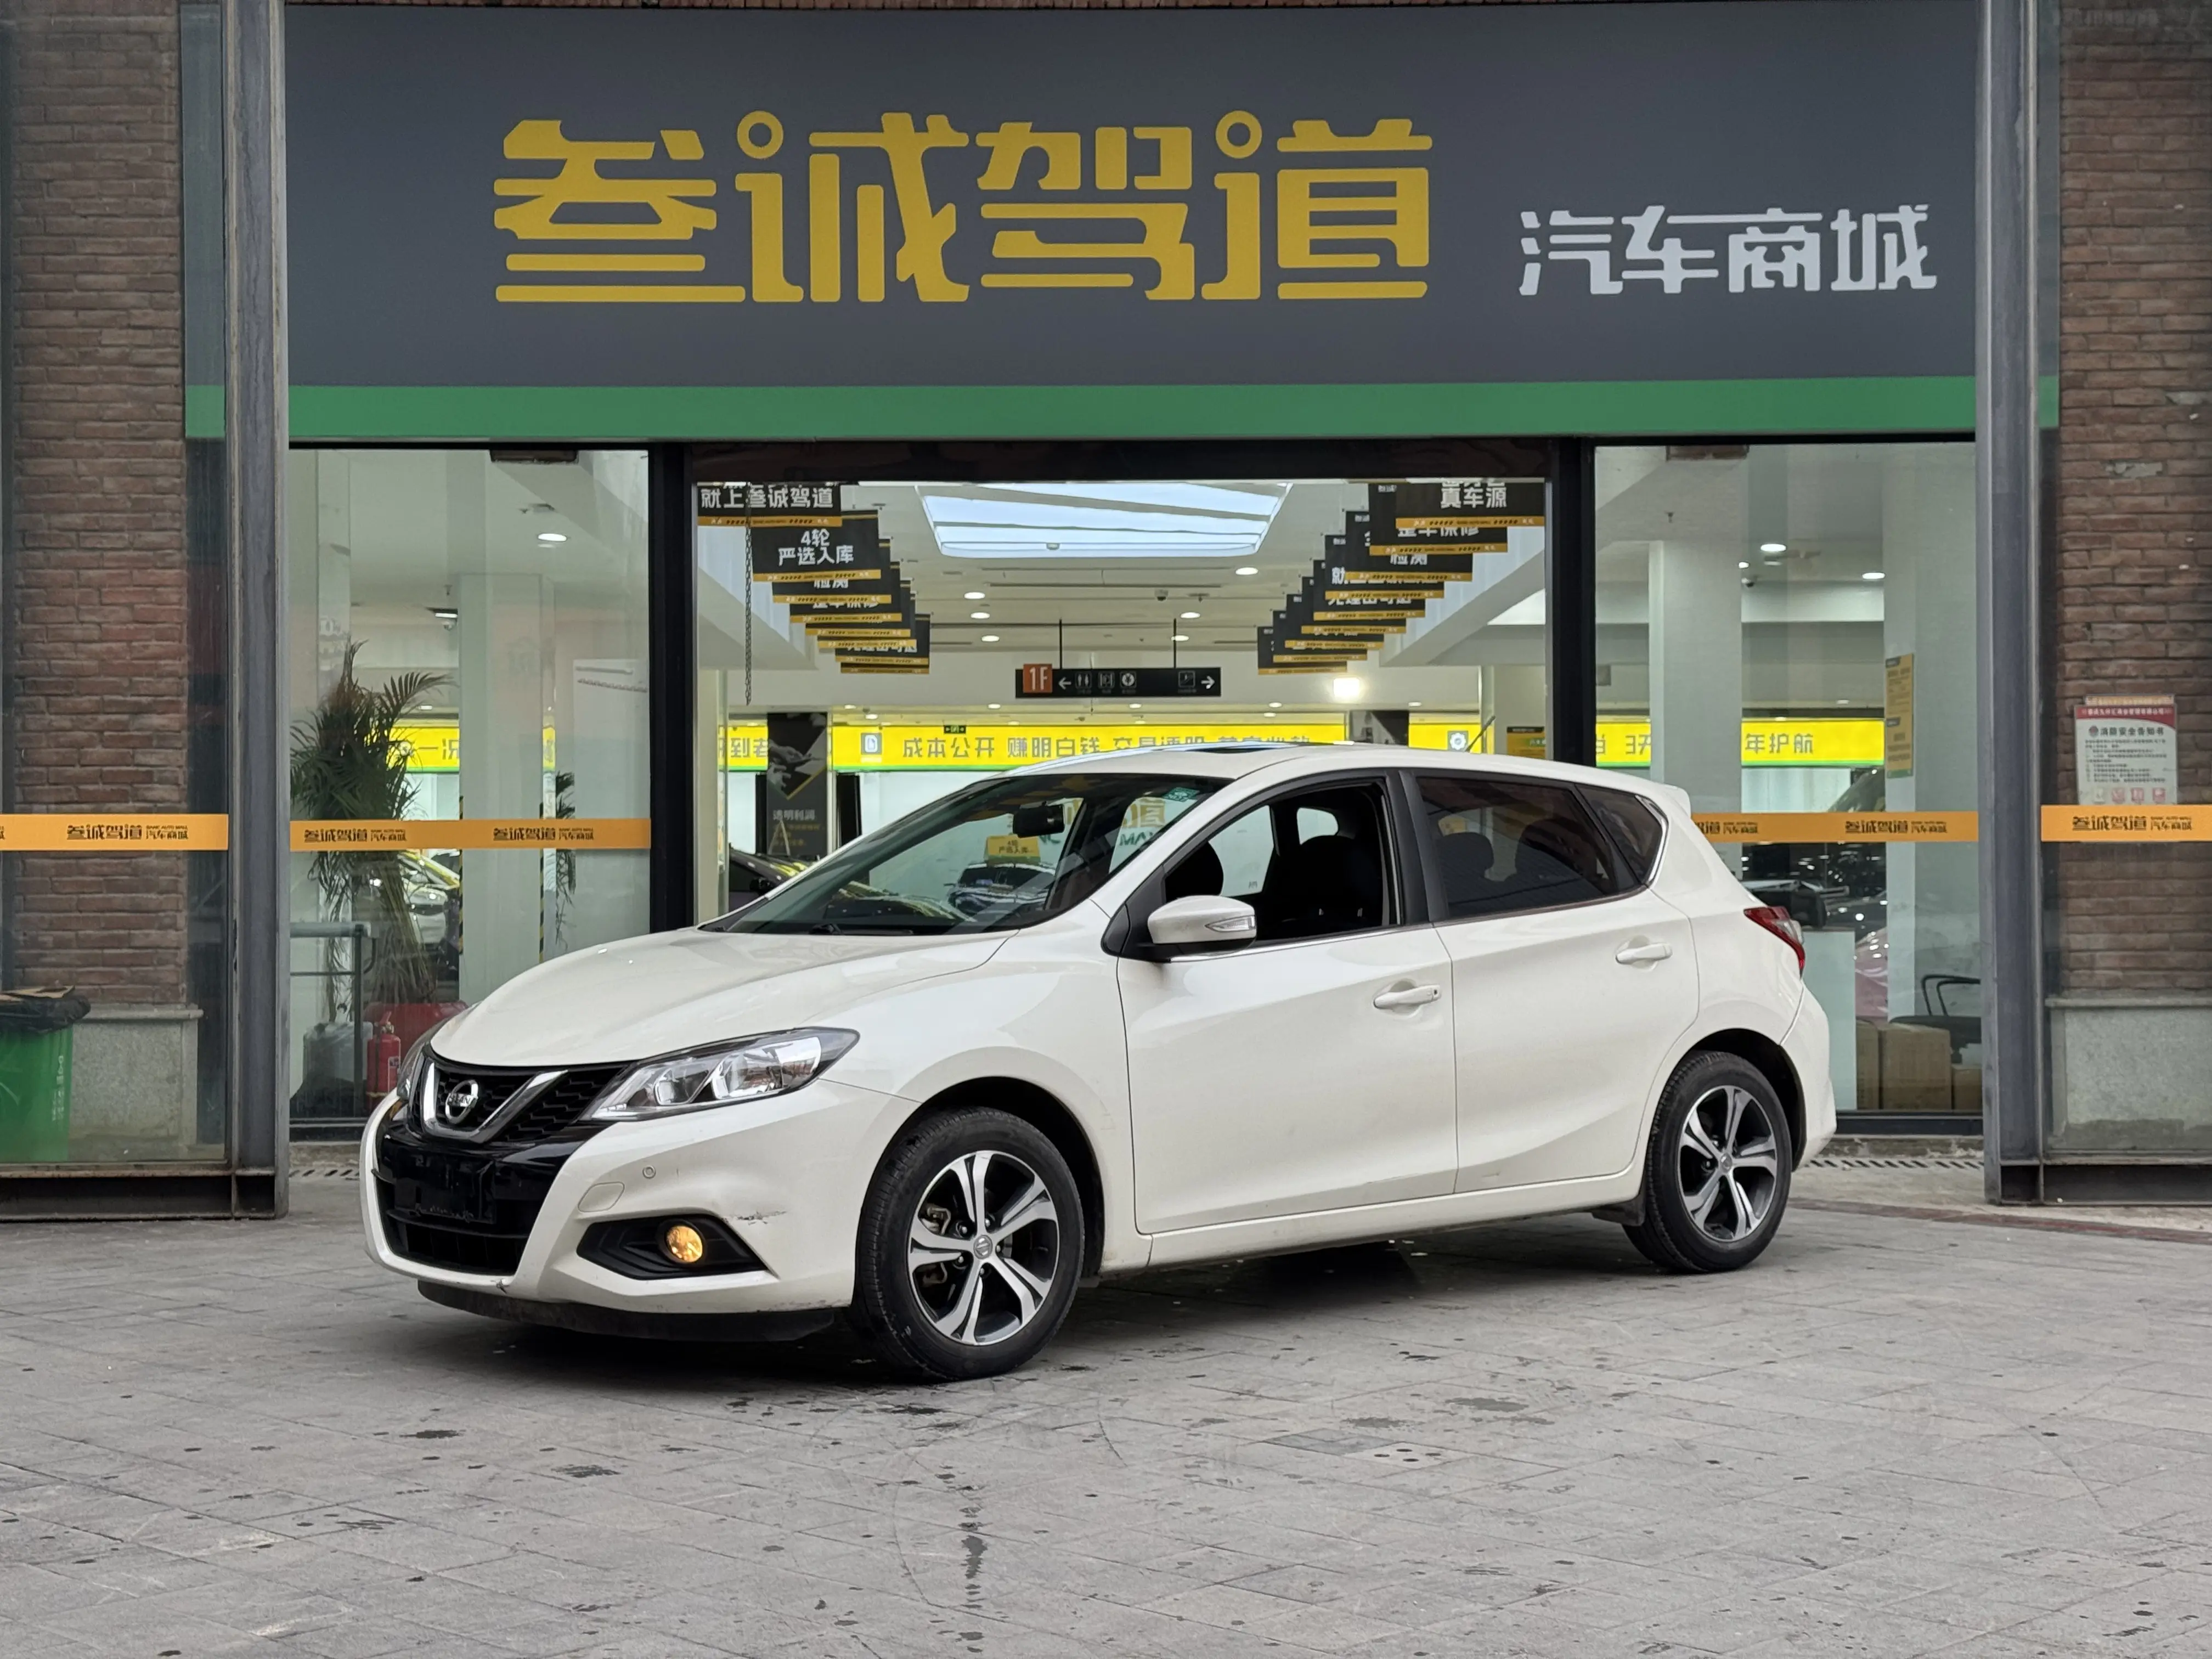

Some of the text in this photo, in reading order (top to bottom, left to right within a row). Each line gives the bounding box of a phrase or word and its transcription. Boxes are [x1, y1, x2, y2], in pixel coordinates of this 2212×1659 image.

[494, 110, 1937, 302] 叁诚驾道 汽车商城
[1440, 487, 1507, 509] 真车源
[800, 528, 830, 548] 4轮
[778, 545, 854, 566] 严选入库
[1029, 666, 1048, 692] 1F
[903, 736, 995, 758] 成本公开
[1007, 736, 1101, 759] 赚明白钱
